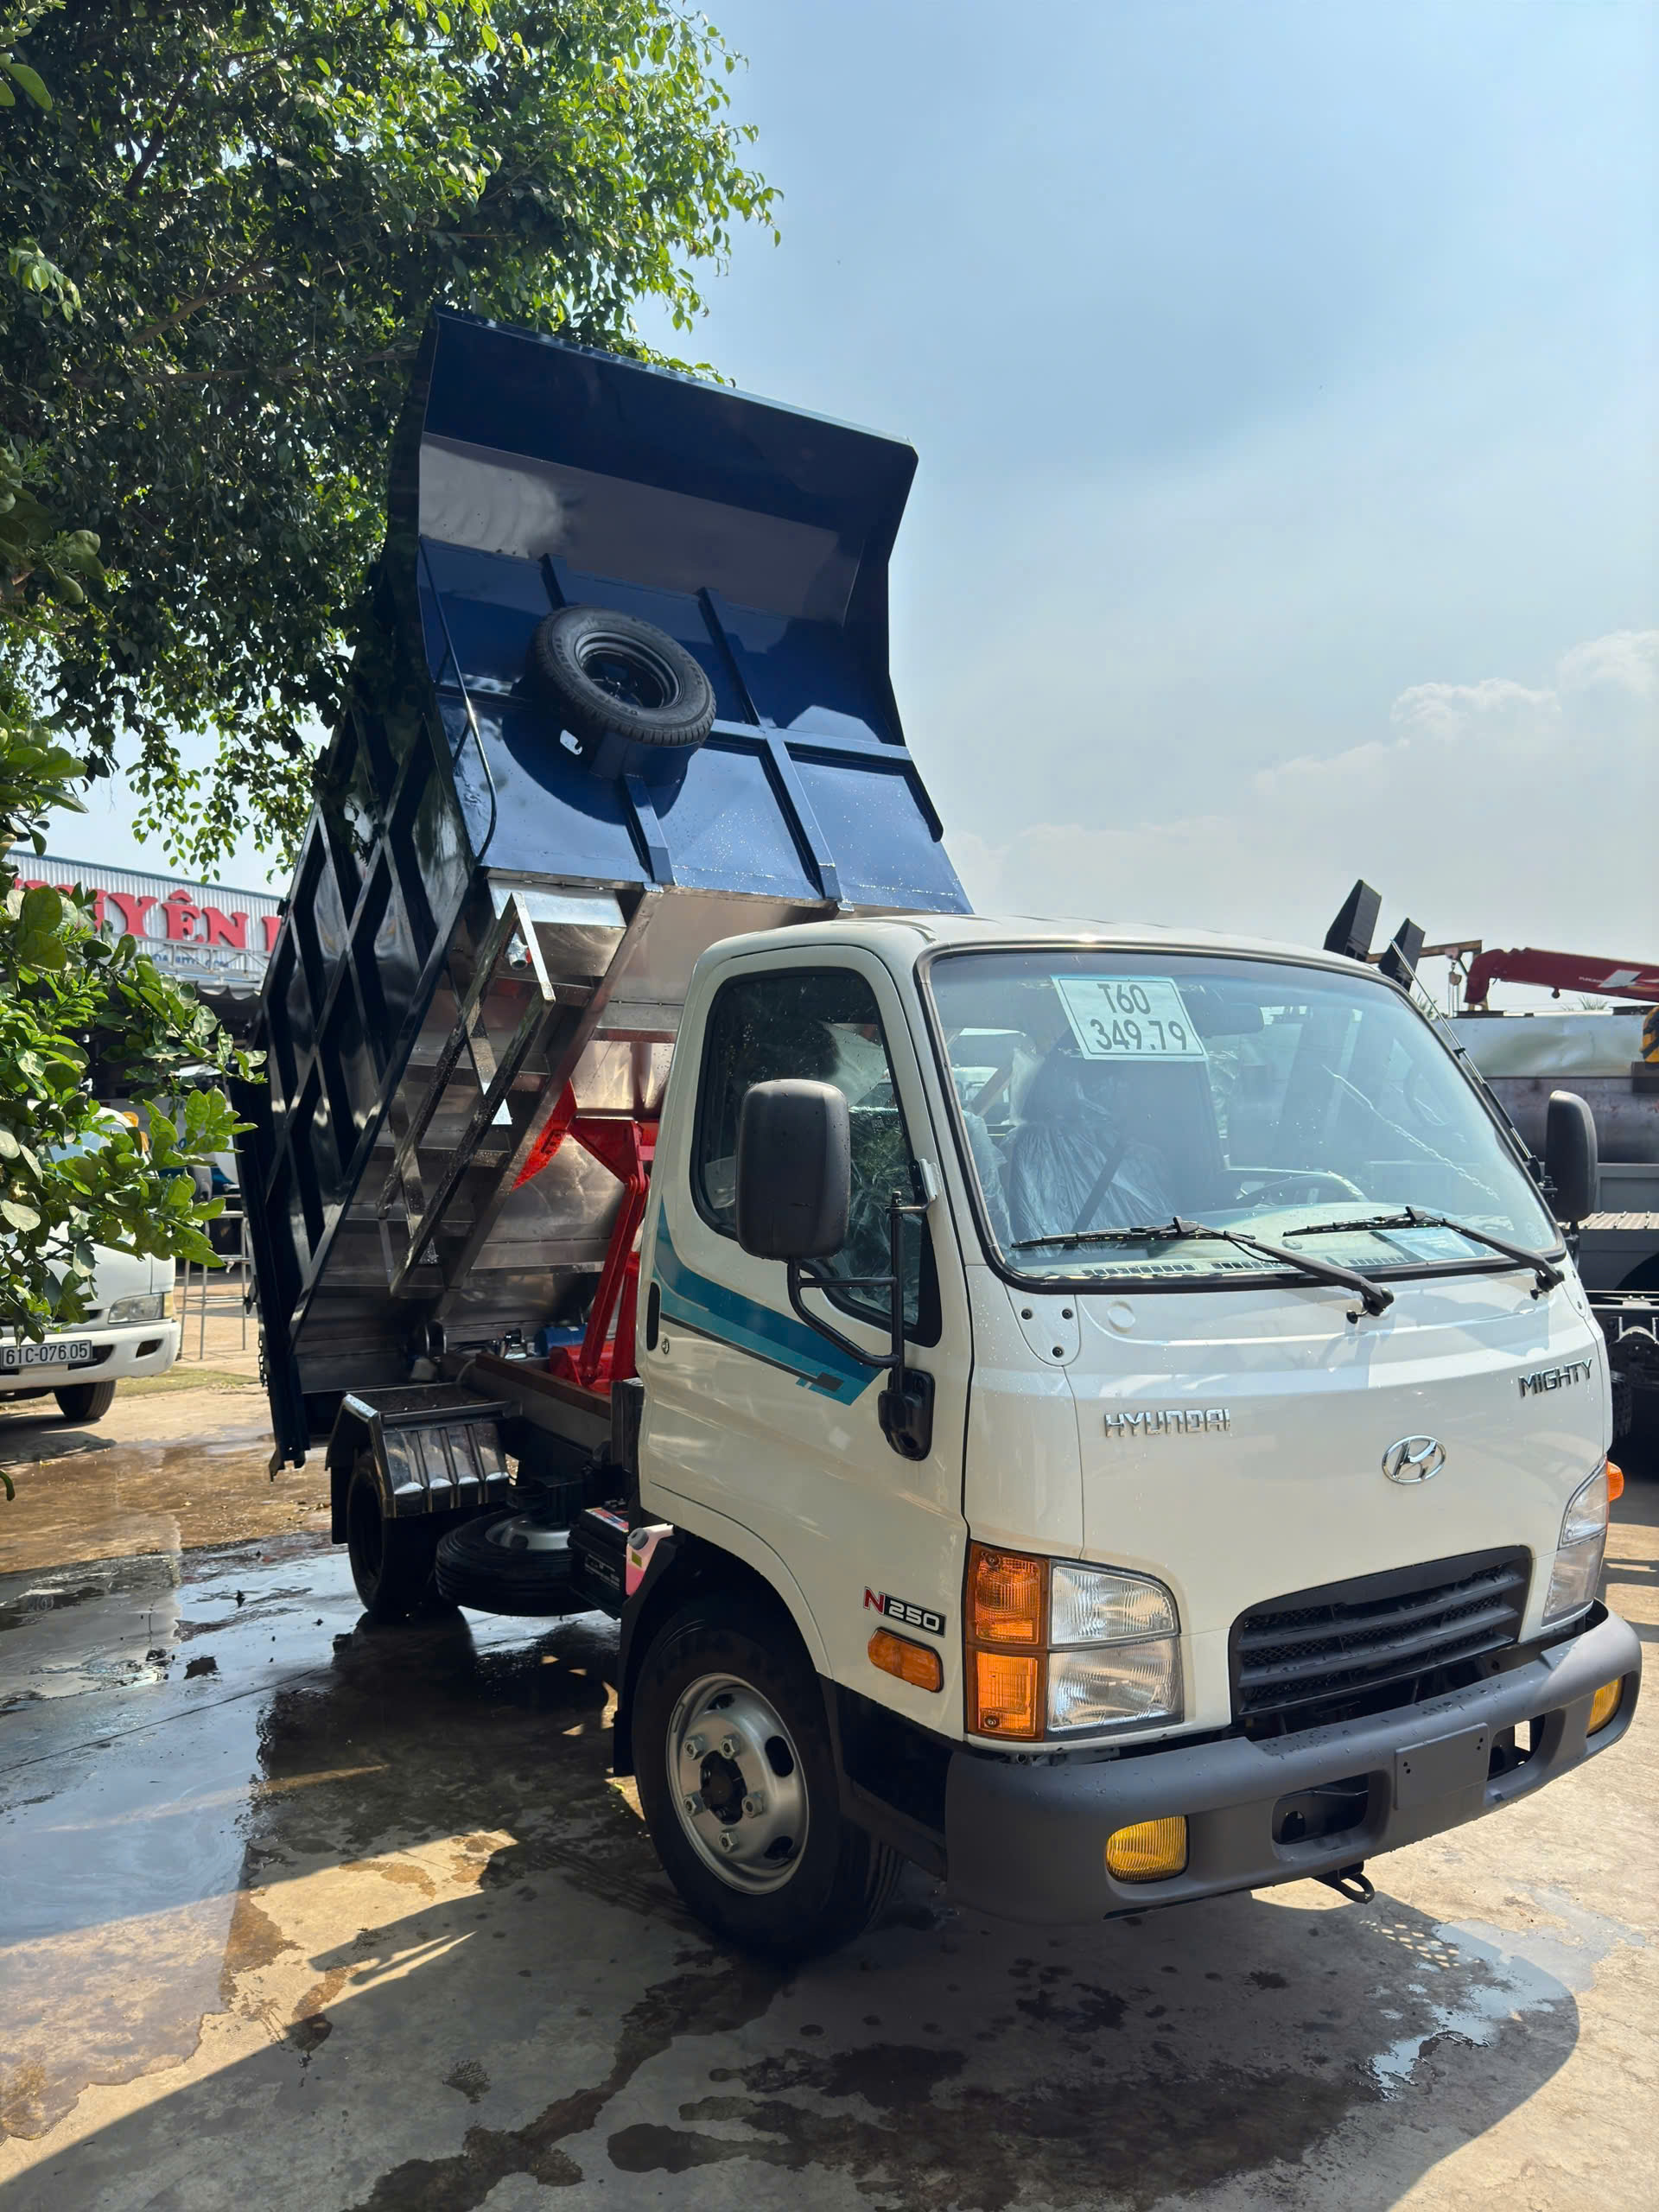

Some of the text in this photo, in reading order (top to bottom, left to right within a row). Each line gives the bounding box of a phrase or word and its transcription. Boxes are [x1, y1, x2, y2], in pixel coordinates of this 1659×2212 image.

[1096, 983, 1151, 1015] T60
[1090, 1018, 1187, 1051] 349.79
[5, 1343, 87, 1365] 61C-076.05
[1517, 1357, 1592, 1398] MIGHTY
[1104, 1408, 1231, 1438] HYUNDAI
